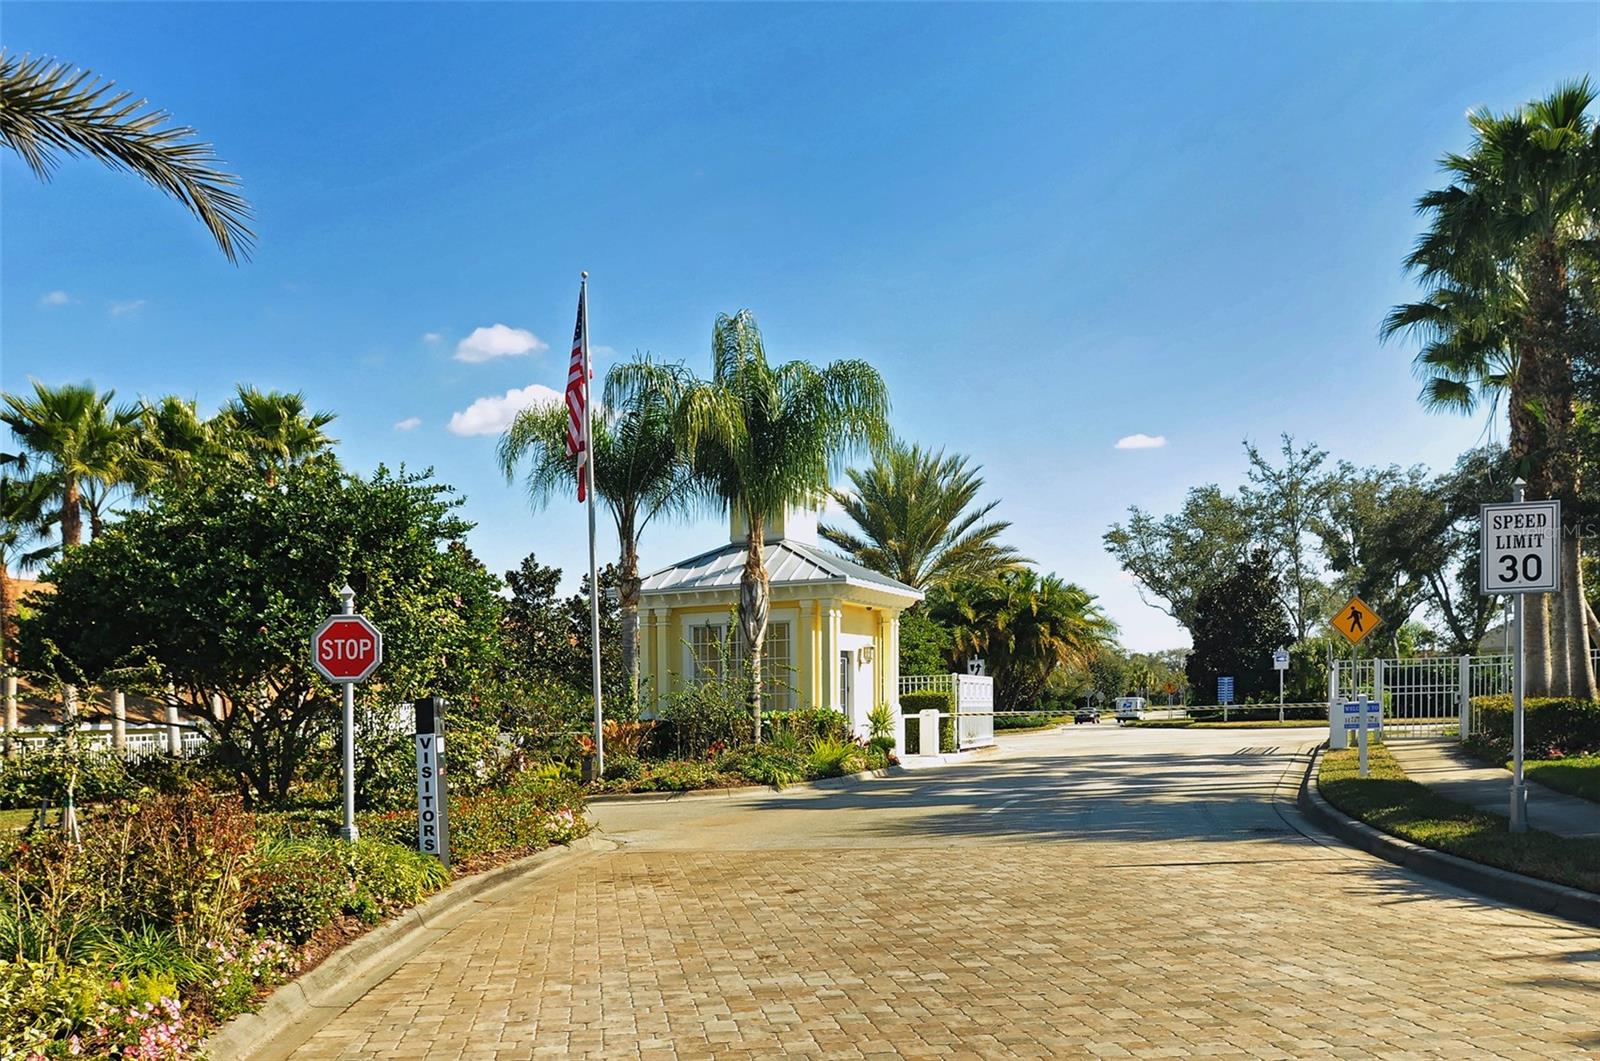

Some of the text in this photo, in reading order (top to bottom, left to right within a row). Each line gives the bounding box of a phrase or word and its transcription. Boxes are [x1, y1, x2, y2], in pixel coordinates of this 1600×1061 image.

[1493, 513, 1547, 530] SPEED
[1496, 533, 1545, 549] LIMIT
[1498, 553, 1542, 583] 30
[321, 638, 372, 660] STOP
[419, 737, 435, 851] VISITORS
